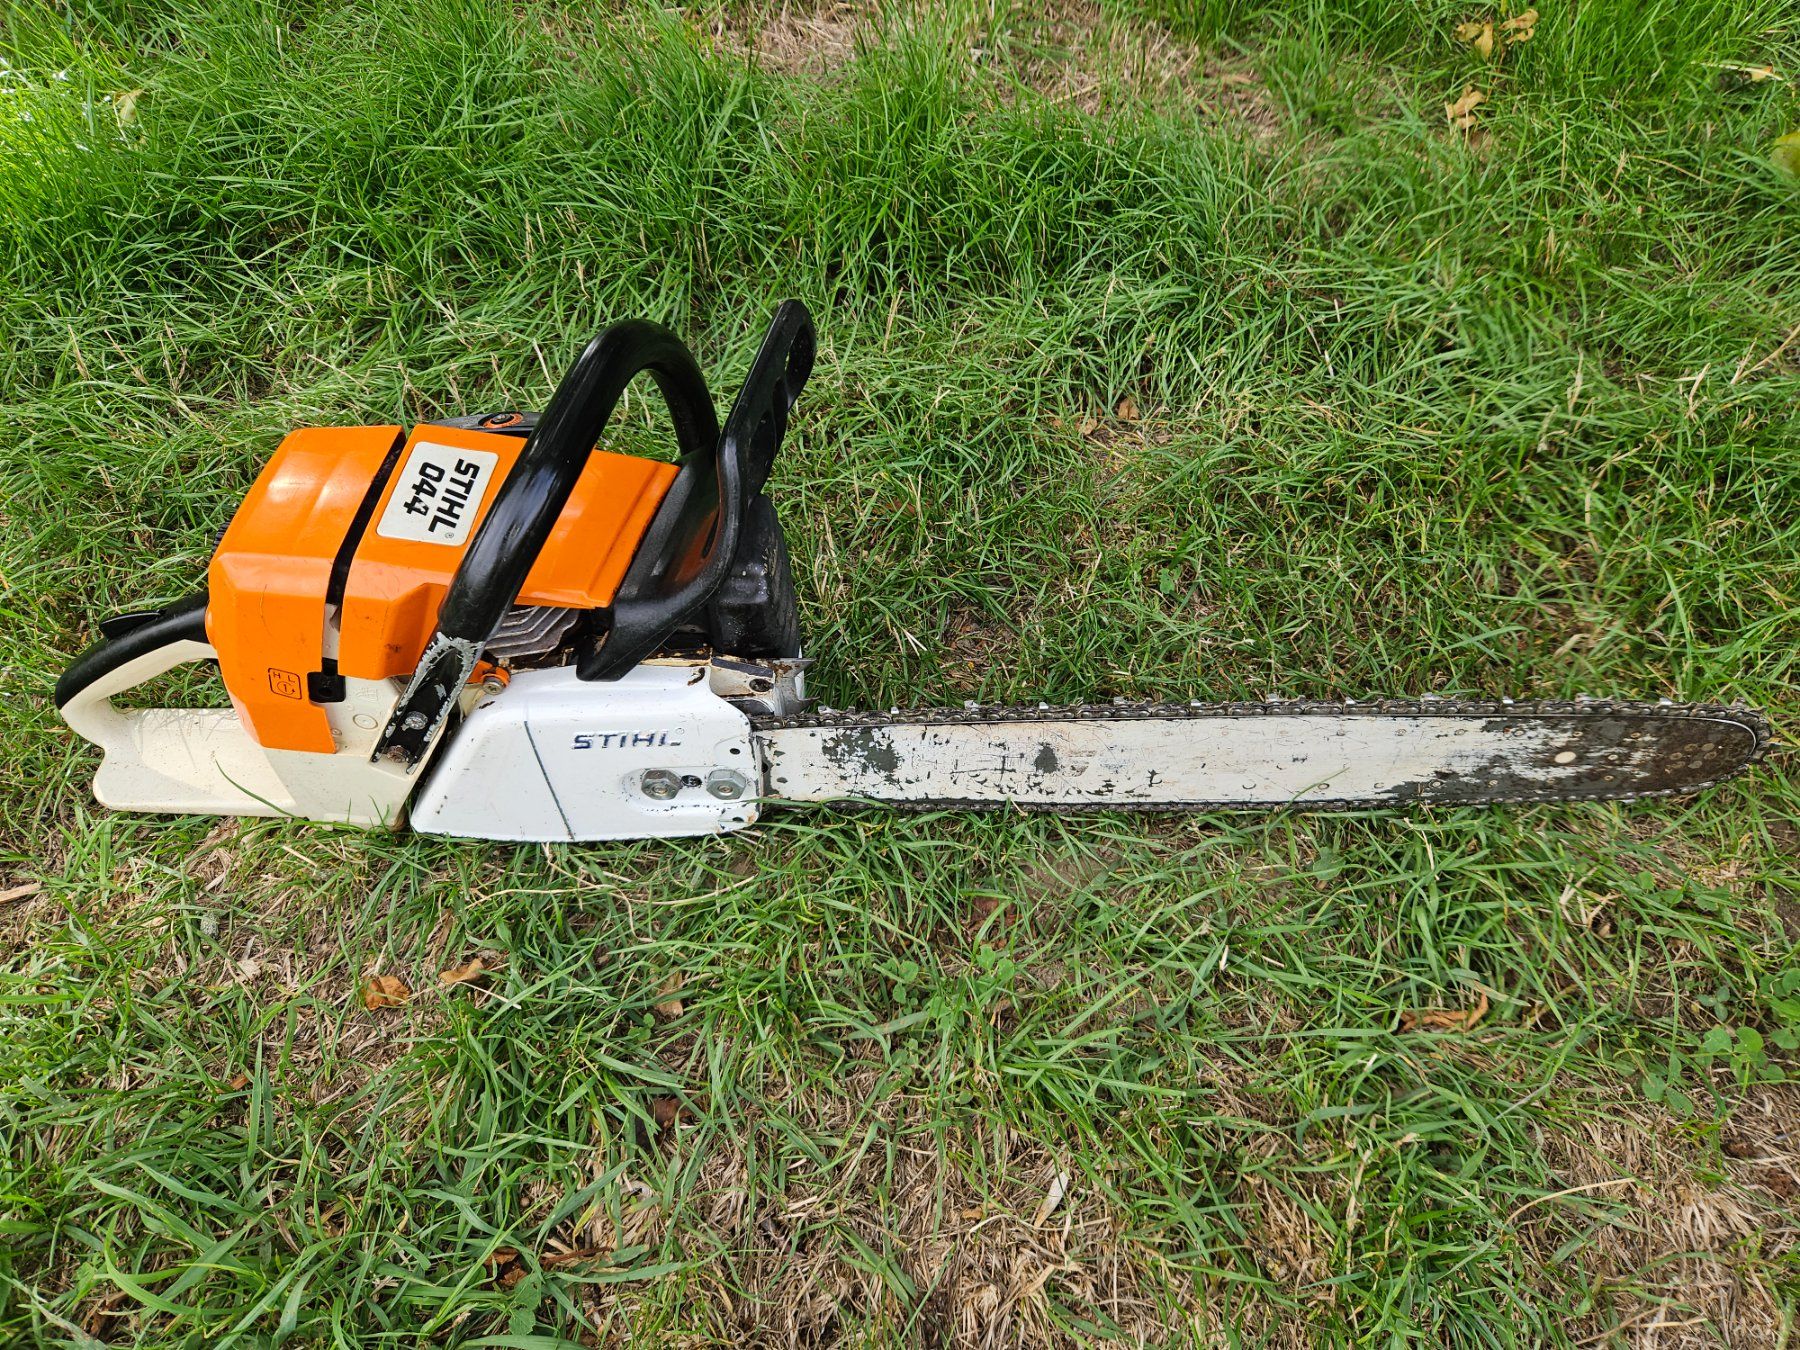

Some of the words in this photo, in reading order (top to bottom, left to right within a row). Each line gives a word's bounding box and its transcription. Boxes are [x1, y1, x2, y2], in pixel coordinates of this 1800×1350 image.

[403, 461, 446, 516] 044
[428, 458, 480, 533] STIHL
[273, 671, 281, 680] H
[287, 675, 296, 684] L
[572, 730, 682, 750] STIHL
